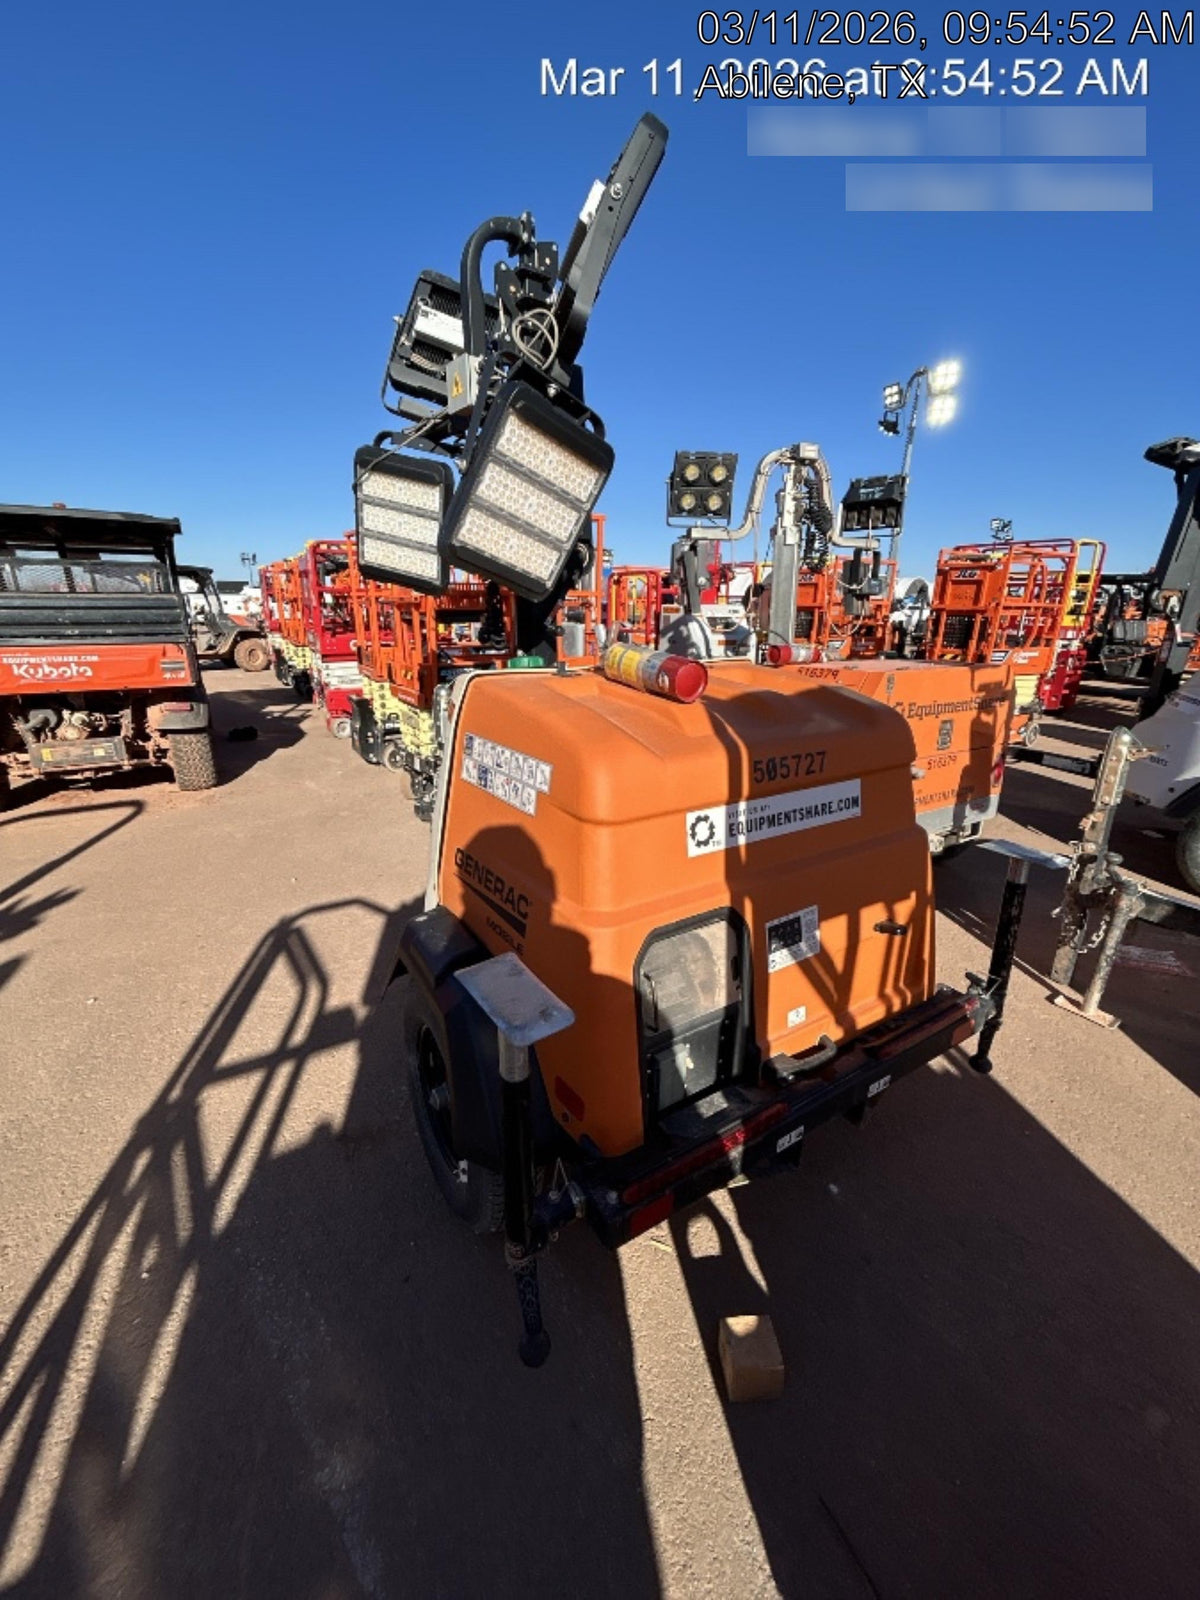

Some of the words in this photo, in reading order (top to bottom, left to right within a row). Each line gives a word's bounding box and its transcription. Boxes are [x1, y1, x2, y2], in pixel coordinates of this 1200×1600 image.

[12, 662, 93, 679] Kubota
[753, 751, 826, 784] 505727
[728, 795, 860, 838] EQUIPMENTSHARE.COM
[455, 847, 529, 920] GENERAC
